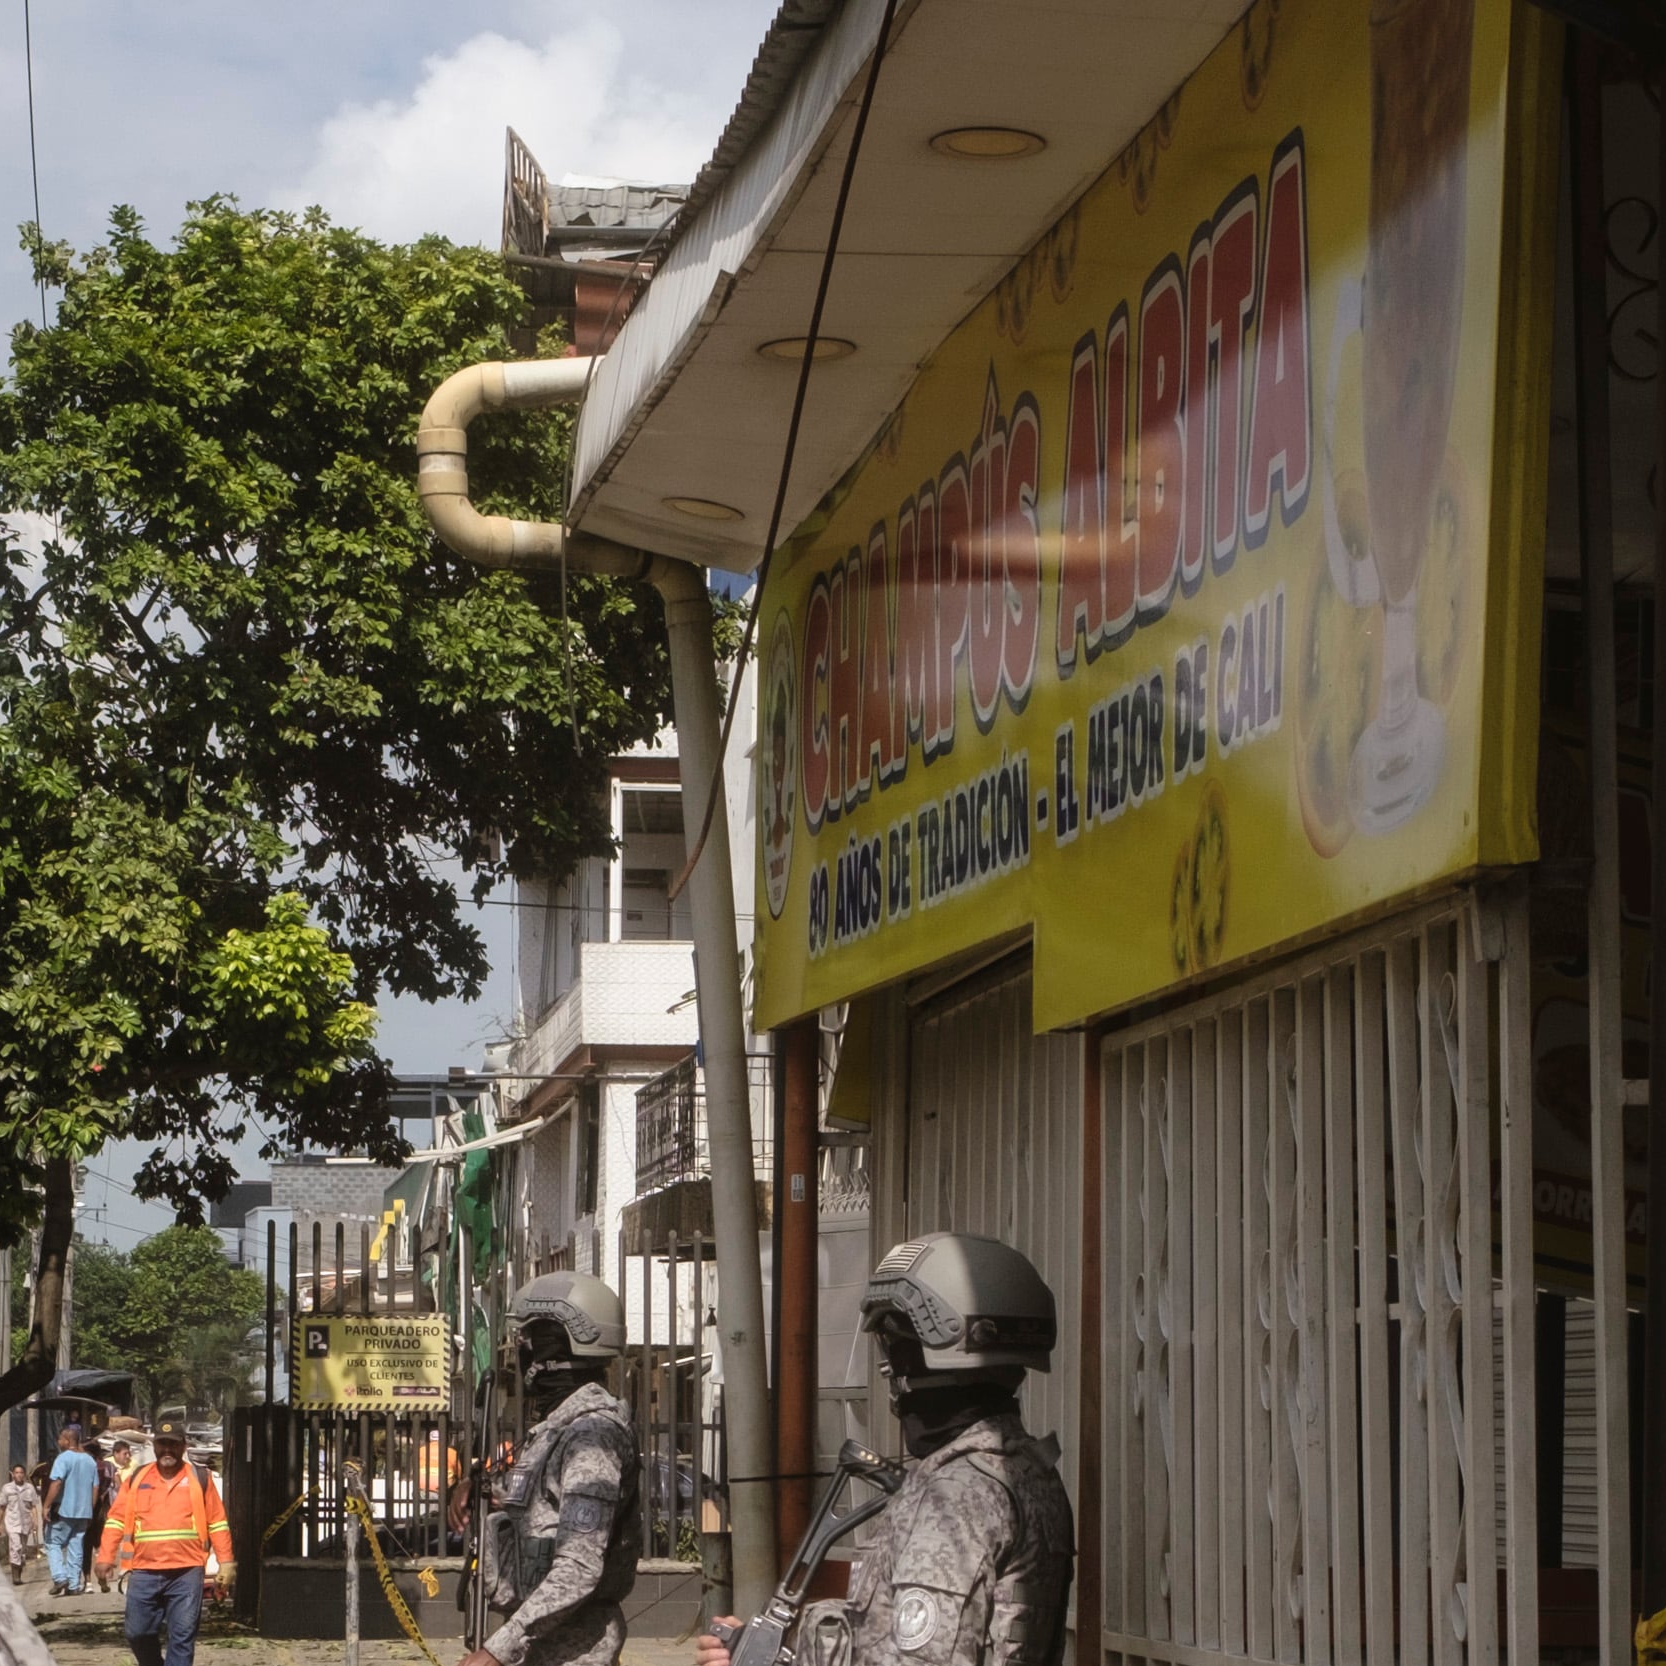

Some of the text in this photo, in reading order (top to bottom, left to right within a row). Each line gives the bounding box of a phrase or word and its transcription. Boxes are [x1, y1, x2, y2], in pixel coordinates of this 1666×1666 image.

[802, 126, 1312, 836] CHAMPÚS ALBITA
[808, 861, 830, 956] 80
[833, 831, 882, 943] AÑOS
[887, 818, 913, 919] DE
[916, 746, 1031, 904] TRADICIÓN
[1055, 726, 1079, 841] EL
[1086, 671, 1166, 824] MEJOR
[1173, 641, 1209, 777] DE
[1215, 588, 1286, 754] CALI
[344, 1325, 441, 1337] PARQUEADERO
[364, 1338, 421, 1350] PRIVADO
[346, 1358, 438, 1369] USO EXCLUSIVO DE
[369, 1371, 415, 1381] CLIENTES
